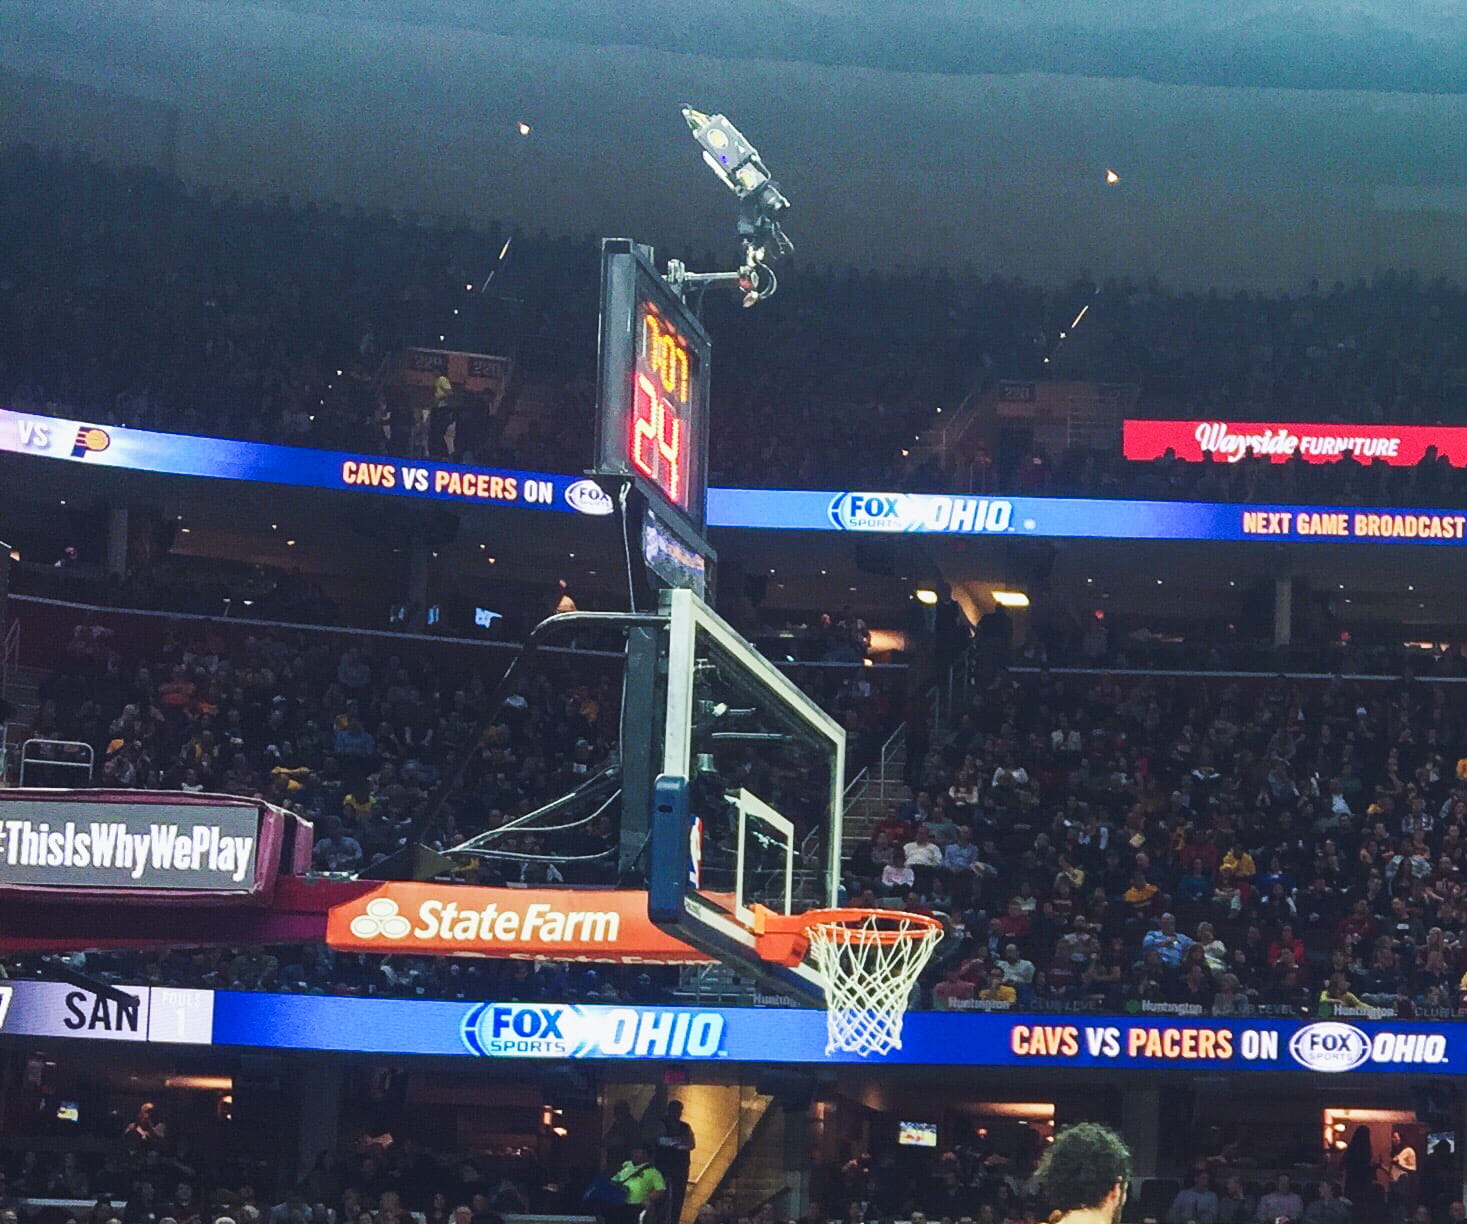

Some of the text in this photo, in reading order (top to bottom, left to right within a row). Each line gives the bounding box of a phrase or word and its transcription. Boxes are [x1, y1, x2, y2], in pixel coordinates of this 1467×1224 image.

[17, 420, 48, 446] VS
[630, 372, 680, 503] 24
[1195, 423, 1401, 463] Wayside FURNITURE
[342, 461, 396, 489] CAVS
[402, 467, 430, 491] VS
[435, 471, 518, 500] PACERS
[523, 478, 553, 504] ON
[850, 495, 898, 518] FOX
[1243, 511, 1291, 536] NEXT
[1297, 513, 1349, 537] GAME
[1354, 515, 1465, 540] BROADCAST
[63, 991, 139, 1032] SAN
[948, 996, 1010, 1012] Huntington
[1142, 1000, 1203, 1015] Huntington
[1333, 1003, 1398, 1019] Huntington
[492, 1007, 564, 1039] FOX
[490, 1039, 566, 1054] SPORTS
[1011, 1025, 1079, 1057] CAVS
[1085, 1027, 1121, 1058] VS
[1129, 1027, 1233, 1060] PACERS
[1241, 1029, 1279, 1060] ON
[1308, 1032, 1352, 1054] FOX
